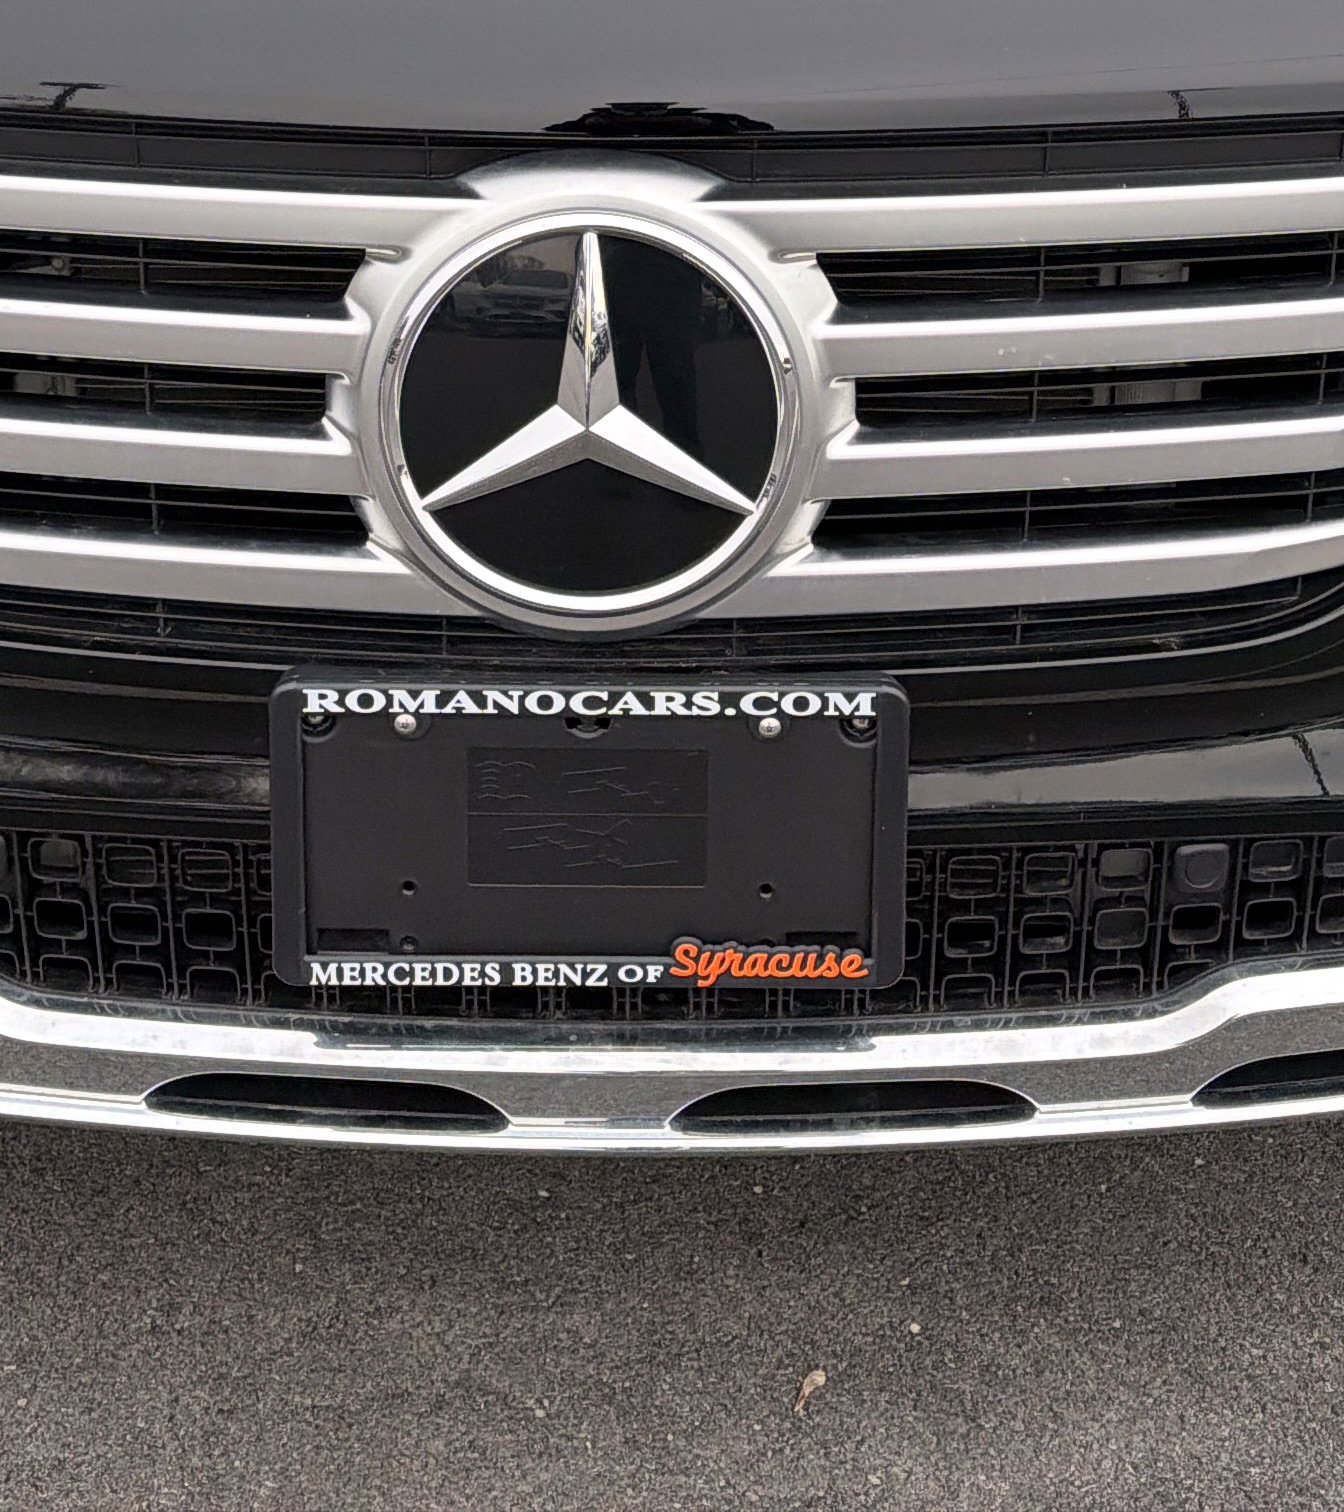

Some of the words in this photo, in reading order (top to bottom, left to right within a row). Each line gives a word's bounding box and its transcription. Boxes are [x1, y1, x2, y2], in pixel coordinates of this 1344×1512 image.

[302, 688, 877, 717] ROMANOCARS.COM
[309, 962, 501, 986] MERCEDES
[512, 963, 609, 986] BENZ
[617, 964, 665, 983] OF
[669, 943, 869, 988] Syracuse
